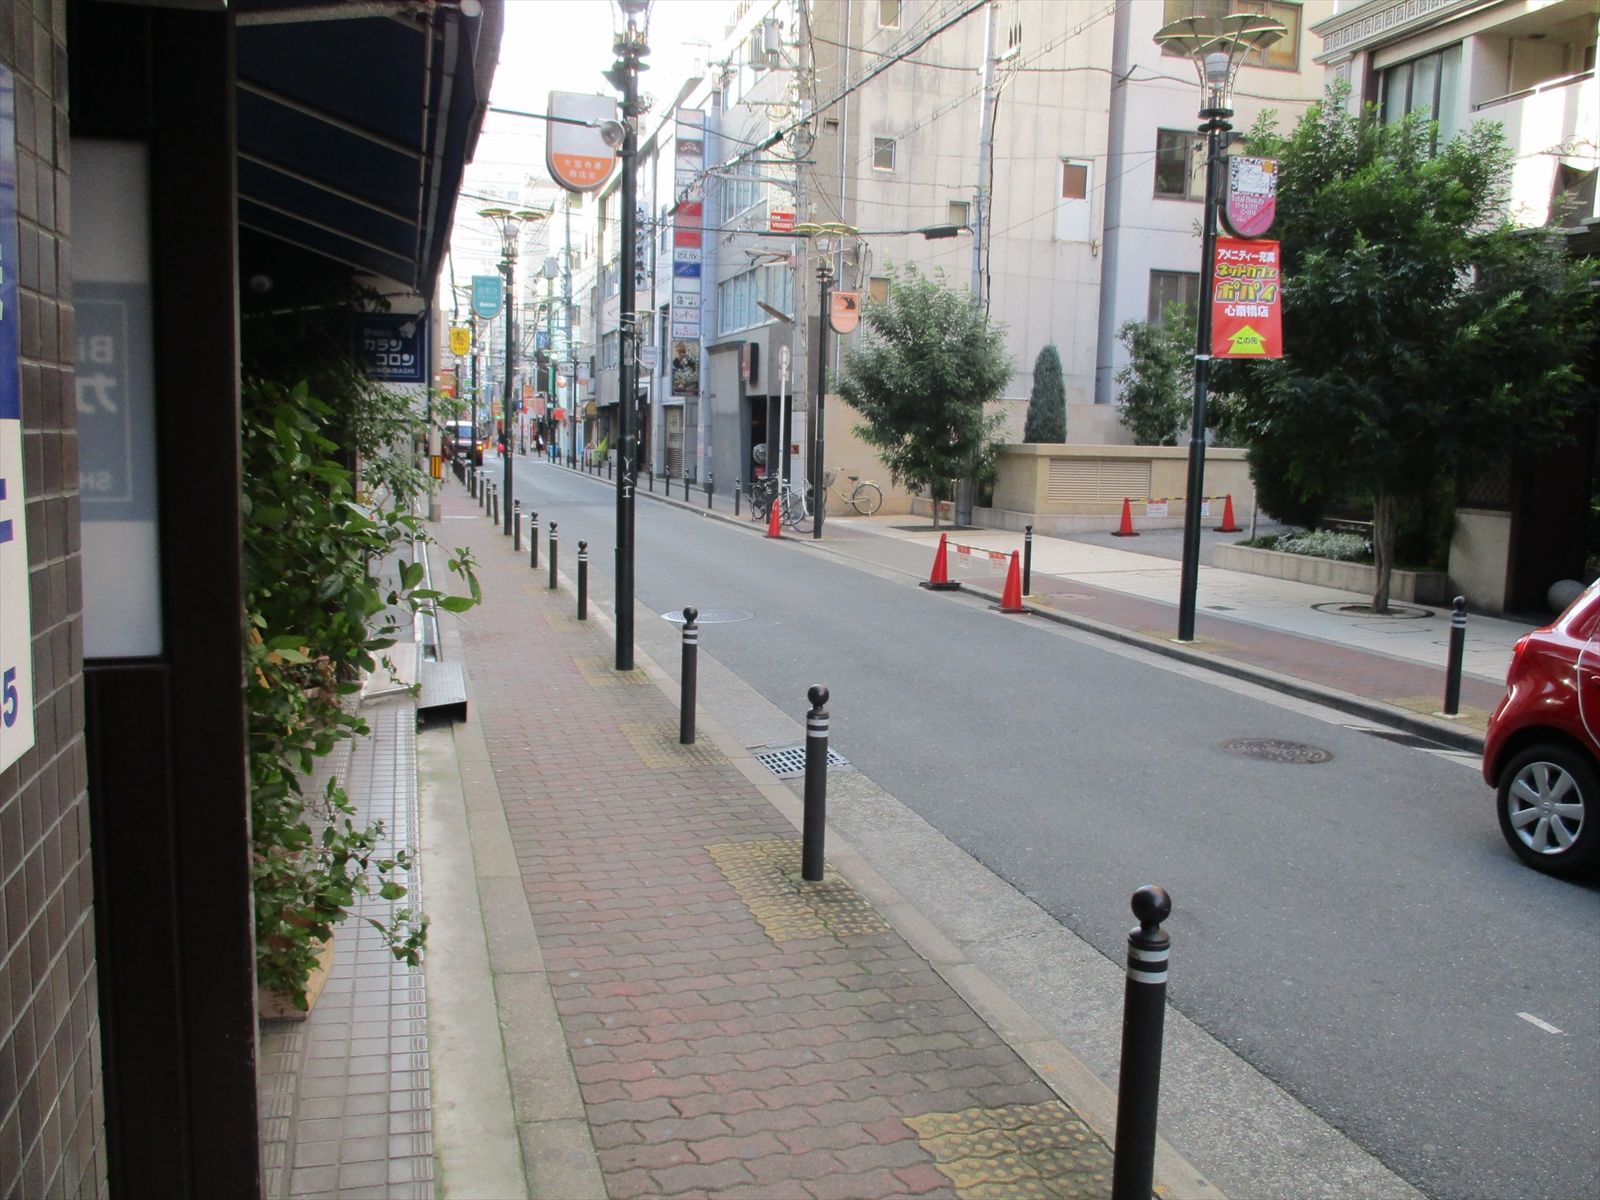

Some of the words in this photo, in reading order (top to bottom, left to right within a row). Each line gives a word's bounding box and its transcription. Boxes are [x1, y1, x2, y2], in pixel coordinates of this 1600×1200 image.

[1216, 263, 1277, 279] ネットカフェ
[1215, 280, 1277, 303] ポパイ
[1236, 336, 1258, 345] この先
[376, 353, 414, 366] コロン
